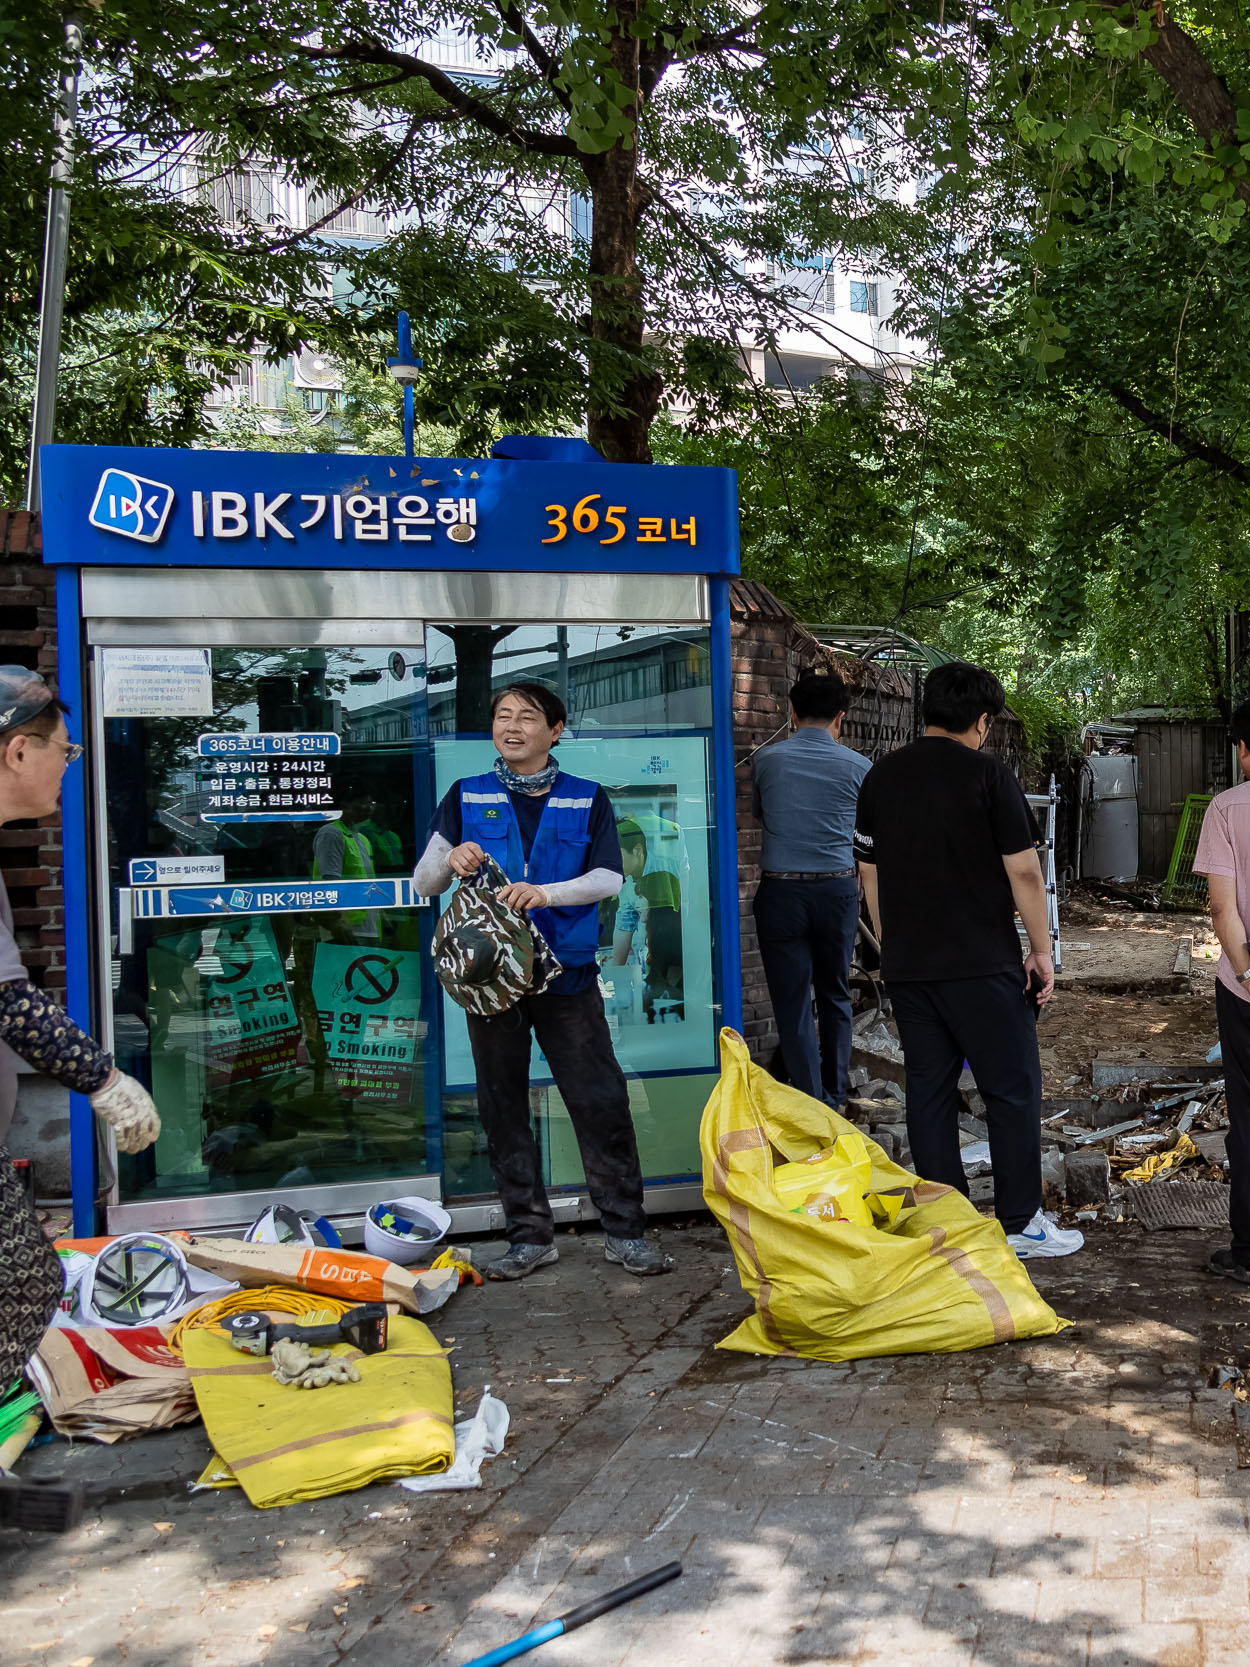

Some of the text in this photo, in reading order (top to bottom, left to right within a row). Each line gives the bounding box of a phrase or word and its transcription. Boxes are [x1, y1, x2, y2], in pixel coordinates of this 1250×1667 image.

[541, 493, 697, 546] 365 코너
[209, 737, 330, 752] 365코너 이용안내
[215, 761, 270, 774] 운영시간
[282, 760, 326, 773] 24시간
[208, 981, 289, 1019] 연구역
[337, 1039, 407, 1059] Smoking
